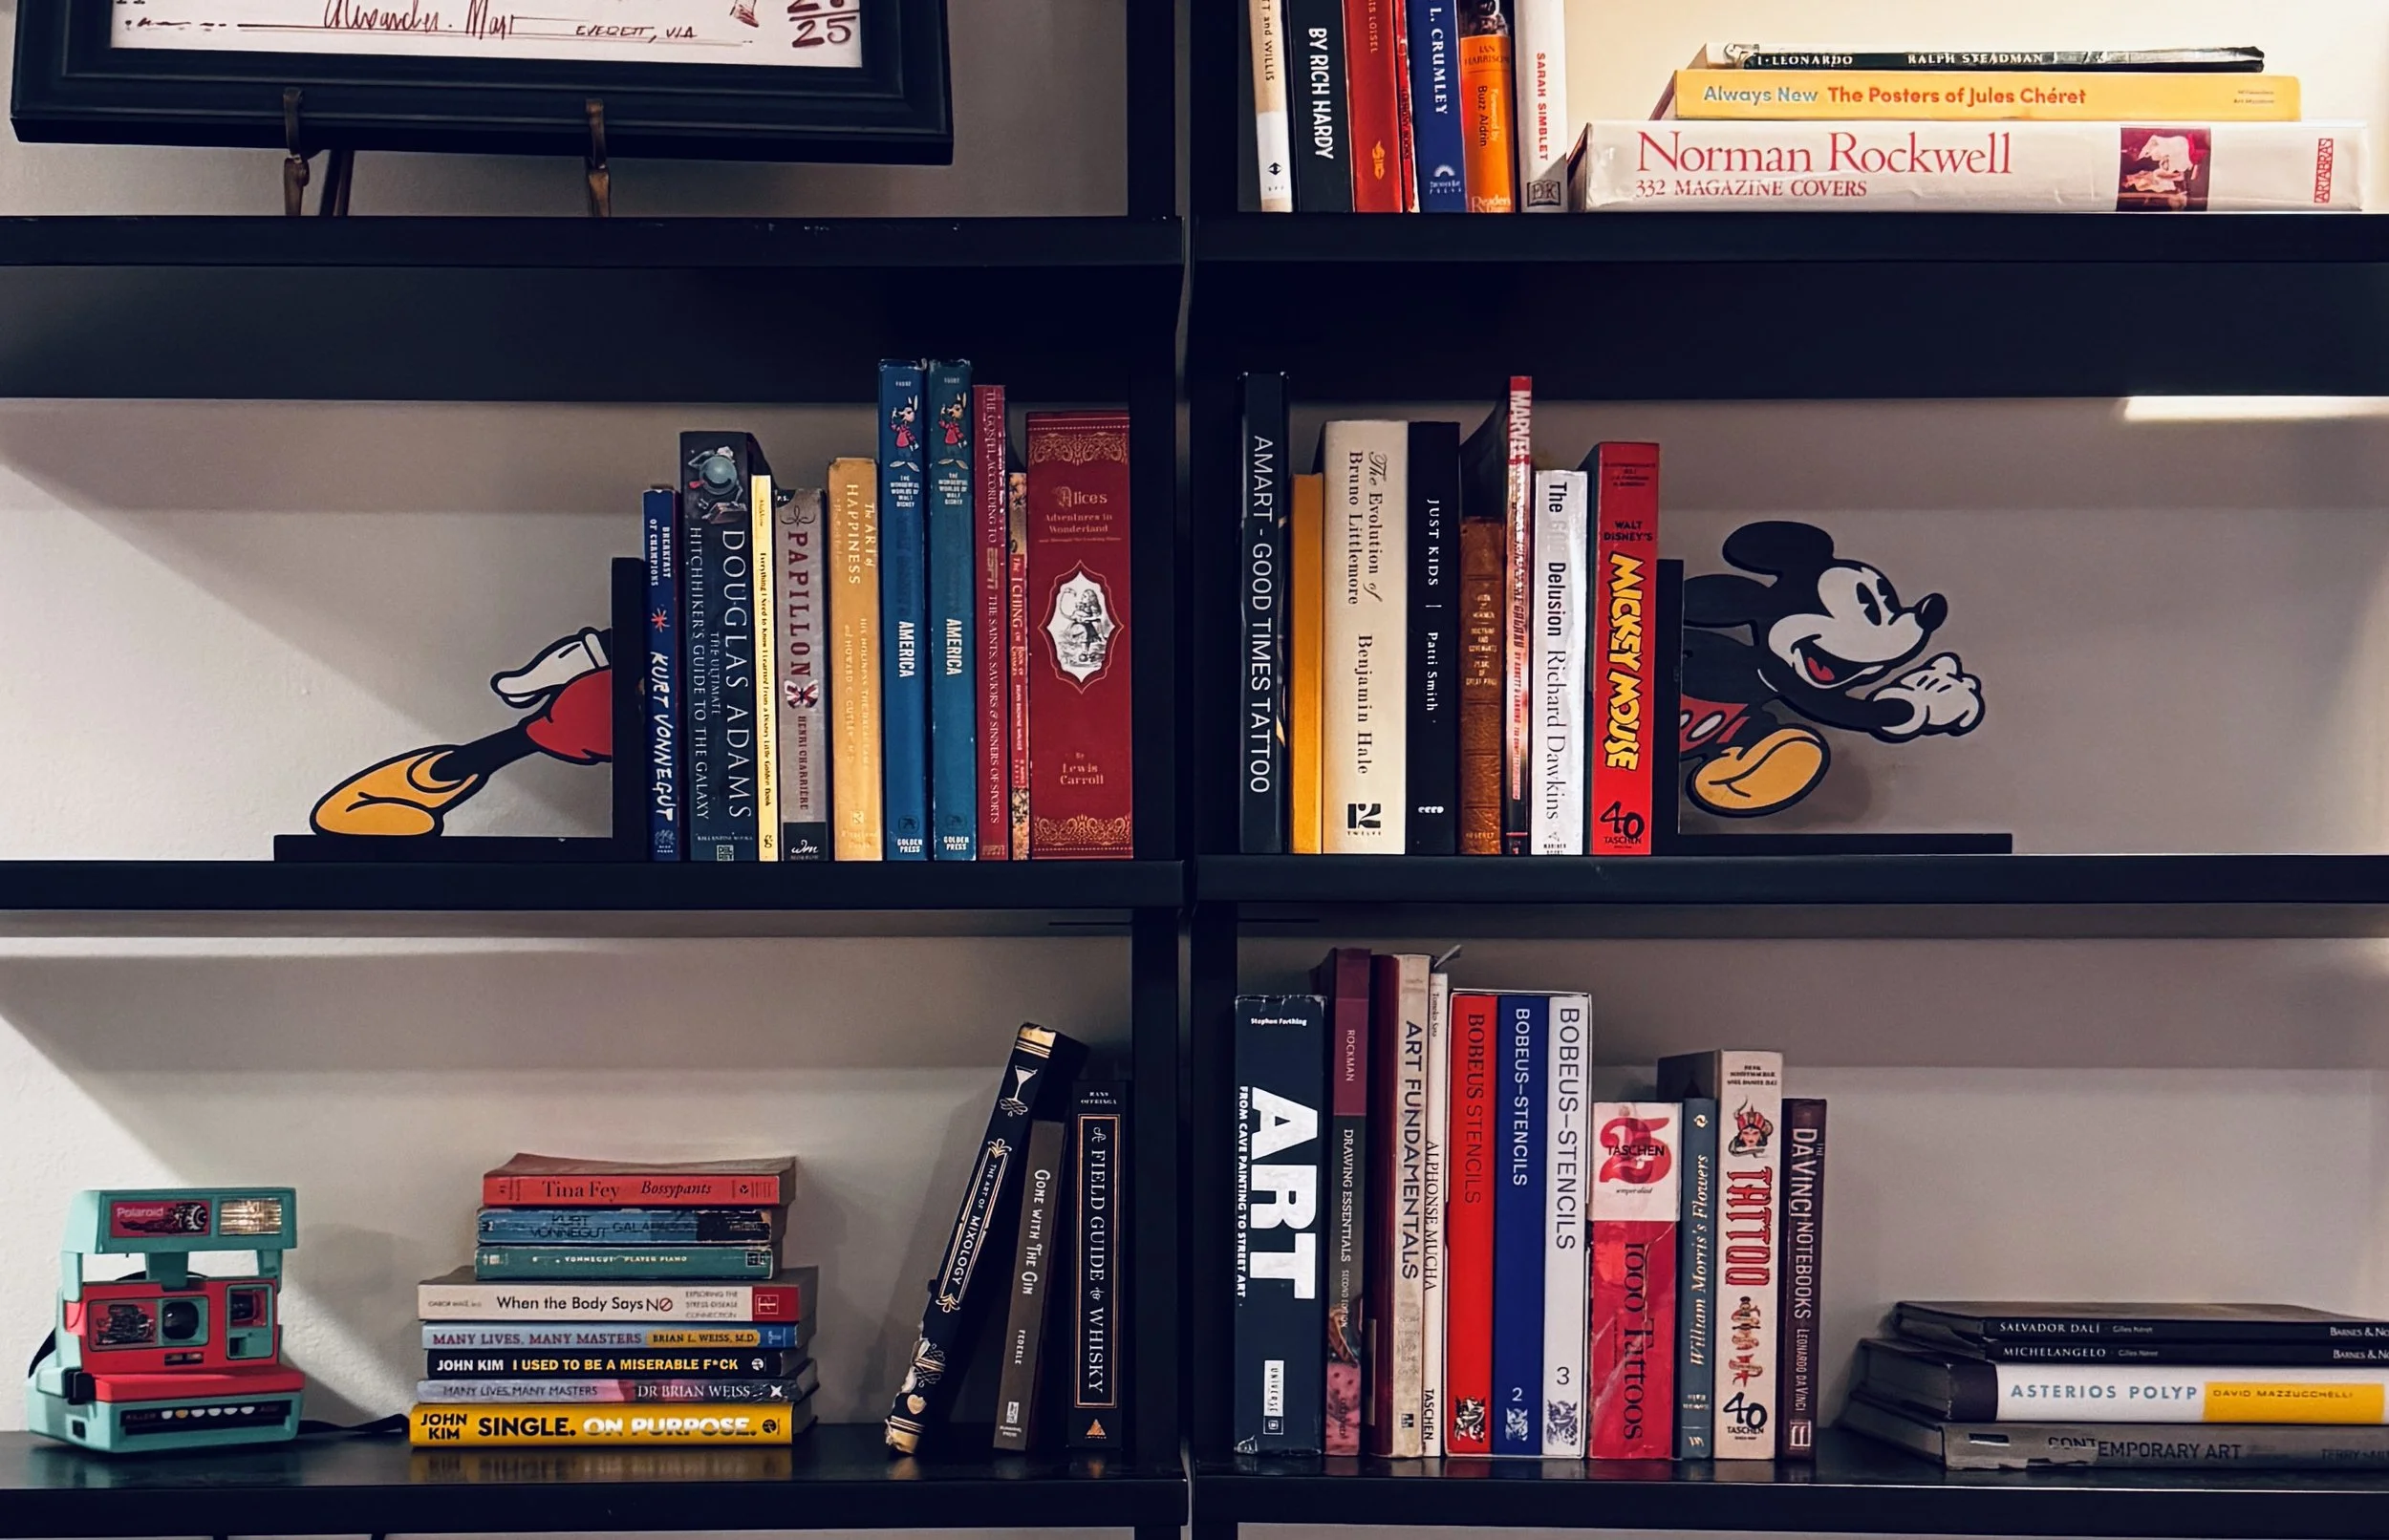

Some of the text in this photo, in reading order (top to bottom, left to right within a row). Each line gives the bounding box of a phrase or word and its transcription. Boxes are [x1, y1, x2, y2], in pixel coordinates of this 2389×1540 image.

[1264, 40, 1275, 81] WILLIS
[1431, 28, 1449, 116] CRUMLEY
[1906, 53, 1956, 66] RALPH
[1307, 27, 1335, 160] BY RICH HARDY
[1477, 85, 1490, 148] Buzz Aldrin
[1536, 53, 1549, 162] SARAH SIMBLET
[1703, 86, 2086, 107] Always New The Posters of Jules Chéret
[1635, 130, 2013, 173] Norman Rockwell
[1635, 179, 1867, 198] 332 MAGAZINE COVERS
[1509, 390, 1532, 460] MARVEL
[1045, 513, 1101, 522] Adventures
[1548, 481, 1568, 513] The
[1614, 520, 1644, 530] WALT
[662, 526, 672, 579] BREAKFAST
[847, 483, 862, 586] HAPPINESS
[1048, 524, 1108, 534] Wonderland
[1346, 451, 1364, 606] Bruno Littlemore
[1367, 492, 1384, 575] Evolution
[1427, 498, 1441, 587] JUST KIDS
[1603, 531, 1654, 543] DISNEY'S
[650, 533, 660, 587] CHAMPIONS
[787, 530, 812, 678] PAPILLON
[1011, 585, 1023, 628] CHING
[1250, 435, 1274, 794] AMART GOOD TIMES TATTOO
[1546, 562, 1567, 637] Delusion
[690, 527, 710, 820] HITCHHIKER'S GUIDE TO THE GALAXY
[722, 530, 752, 818] DOUGLAS ADAMS
[899, 620, 915, 678] AMERICA
[946, 617, 963, 675] AMERICA
[1426, 631, 1440, 712] Patti Smith
[1603, 551, 1646, 772] MICKEY MOUSE
[650, 651, 671, 709] KURT
[987, 527, 1000, 824] TO THE SAVIORS SINNERS OF SPORTS
[1545, 650, 1568, 727] Richard
[797, 716, 807, 747] HENRI
[1353, 633, 1374, 776] Benjamin Hale
[652, 714, 678, 822] VONNEGUT
[1060, 774, 1105, 785] Carroll
[1062, 763, 1098, 773] Lewis
[1545, 735, 1568, 821] Dawkins
[1279, 1017, 1308, 1027] Farthing
[1405, 1019, 1424, 1073] ART
[1345, 1029, 1357, 1082] ROCKMAN
[1463, 1013, 1486, 1206] BOBEUS STENCILS
[1607, 1144, 1666, 1157] TASCHEN
[541, 1179, 713, 1203] Tina Fey Bossypants
[1236, 1085, 1250, 1297] FROM CAVE PAINTING TO STREET ART
[1249, 1085, 1319, 1300] ART
[1340, 1128, 1355, 1263] DRAWING ESSENTIALS
[1401, 1079, 1424, 1280] FUNDAMENTALS
[117, 1205, 165, 1222] Polaroid
[951, 1164, 998, 1286] THE ART MIXOLOGY
[1021, 1168, 1052, 1295] GONE WITH THE GIN
[1423, 1140, 1440, 1292] ALPHONSE MUCHA
[1724, 1166, 1774, 1286] TATTOO
[1087, 1149, 1107, 1395] FIELD GUIDE WHISKY
[1689, 1153, 1709, 1366] William Flowers
[496, 1295, 540, 1311] When
[544, 1295, 568, 1310] the
[571, 1295, 609, 1314] Body
[611, 1295, 644, 1314] Says
[1794, 1221, 1815, 1373] NOTEBOOKS LEONARDO
[432, 1333, 684, 1346] MANY LIVES, MANY MASTERS BRIAN
[1997, 1320, 2101, 1335] SALVADOR DALÍ
[2003, 1346, 2107, 1358] MICHELANGELO
[436, 1358, 699, 1372] JOHN KIM USED TO BE A MISERABLE
[442, 1383, 751, 1399] MANY MANY MASTERS DR BRIAN WEISS
[1556, 1366, 1571, 1385] 3
[1623, 1318, 1655, 1442] Tattoos
[2010, 1384, 2354, 1401] ASTERIOS POLYP DAVID MAZZUCCHELLI
[420, 1413, 468, 1426] JOHN
[1422, 1388, 1435, 1441] TASCHEN
[1512, 1386, 1523, 1402] 2
[1722, 1391, 1768, 1430] 40
[428, 1426, 461, 1441] KIM
[477, 1416, 758, 1438] SINGLE. ON PURPOSE.
[2204, 1444, 2243, 1460] ART
